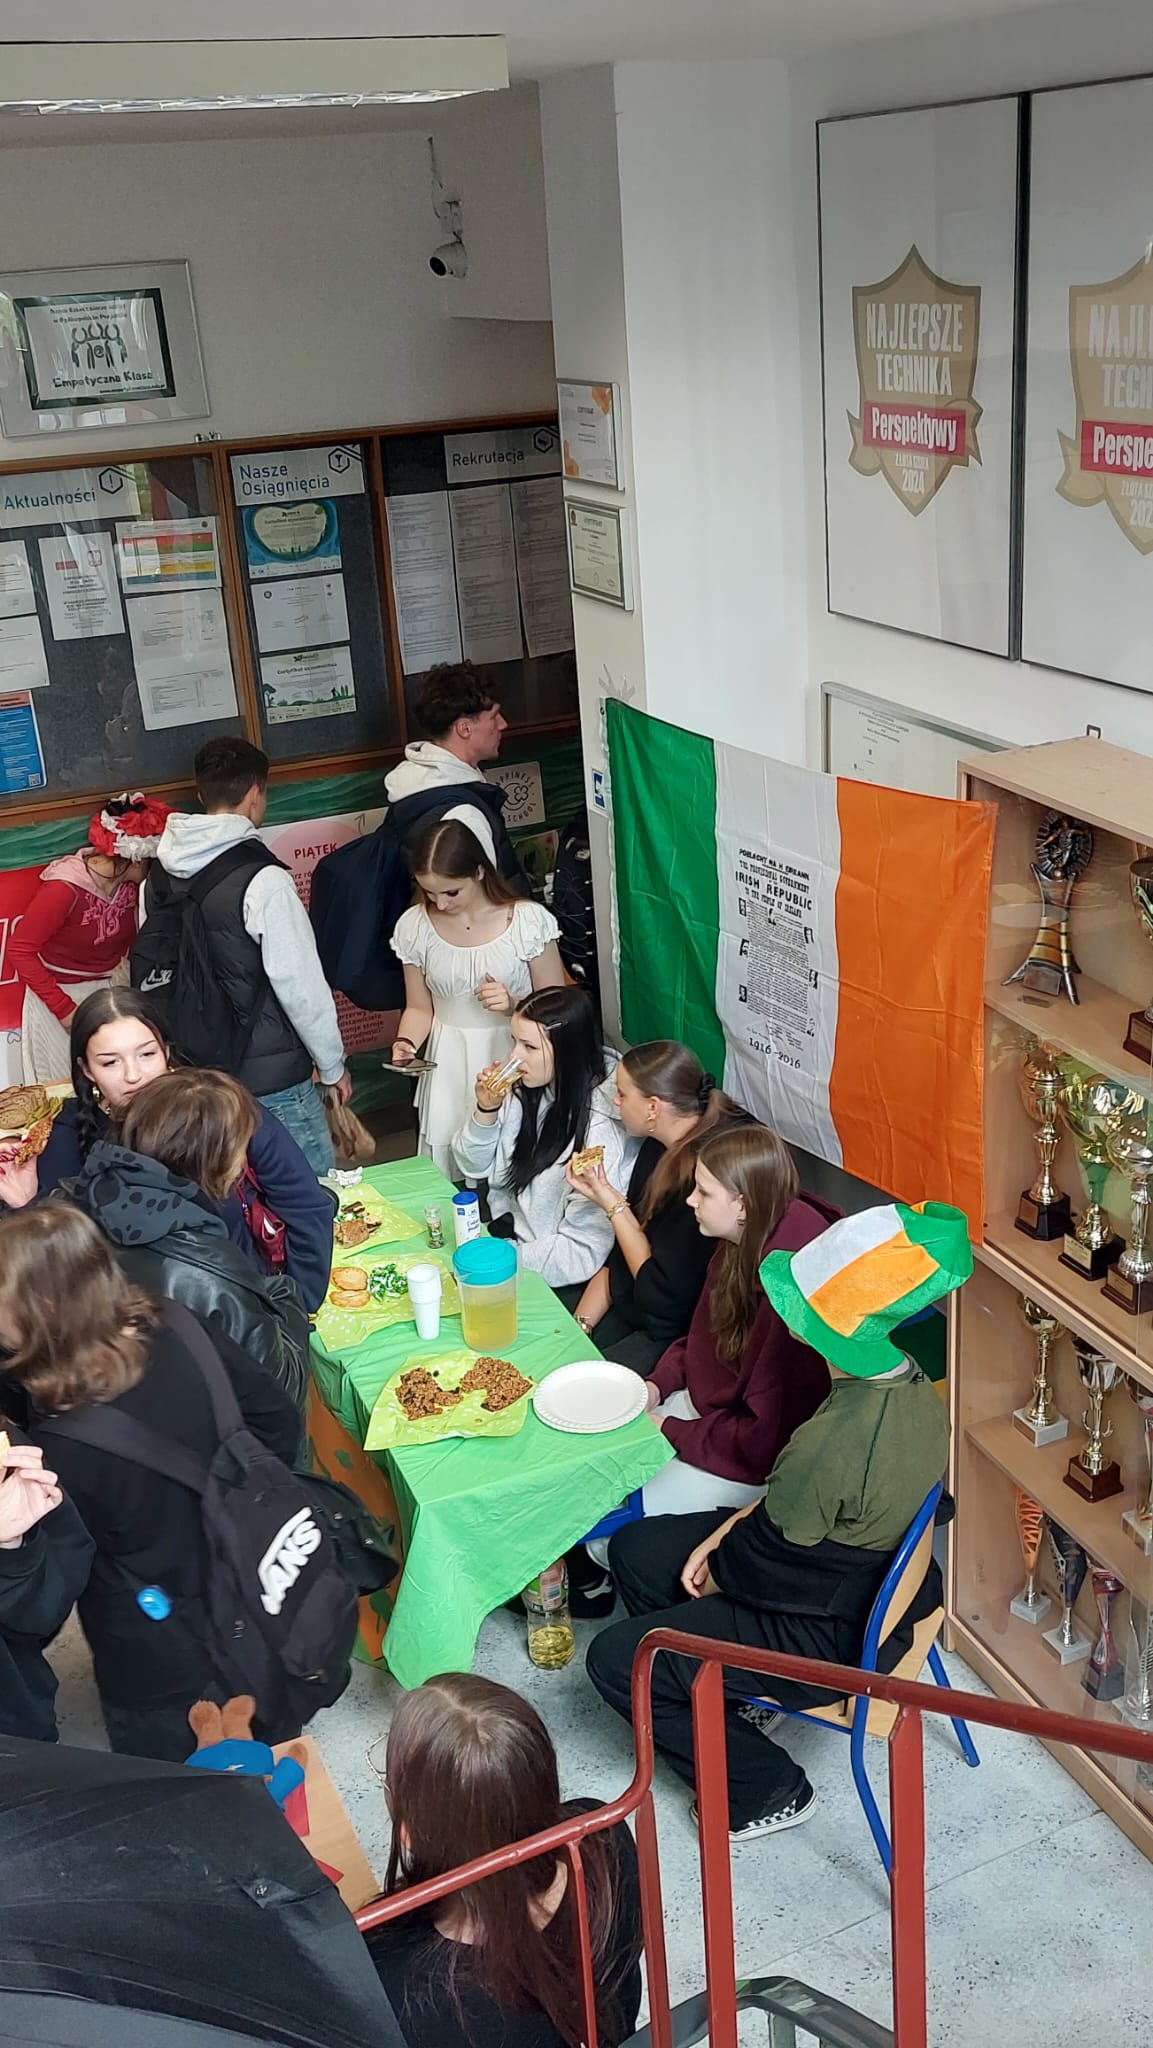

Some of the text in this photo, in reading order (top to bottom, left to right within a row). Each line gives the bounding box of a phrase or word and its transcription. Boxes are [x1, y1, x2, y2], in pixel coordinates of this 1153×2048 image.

[866, 303, 963, 353] NAJLEPSZE
[876, 354, 953, 396] TECHNIKA
[872, 407, 957, 451] Perspektywy
[452, 450, 525, 467] Rekrutacja
[239, 463, 288, 480] Nasze
[242, 474, 330, 497] Osiągnięcia
[4, 487, 97, 510] Aktualności
[294, 842, 337, 860] PIĄTEK
[735, 870, 813, 911] IRISH REPUBLIC
